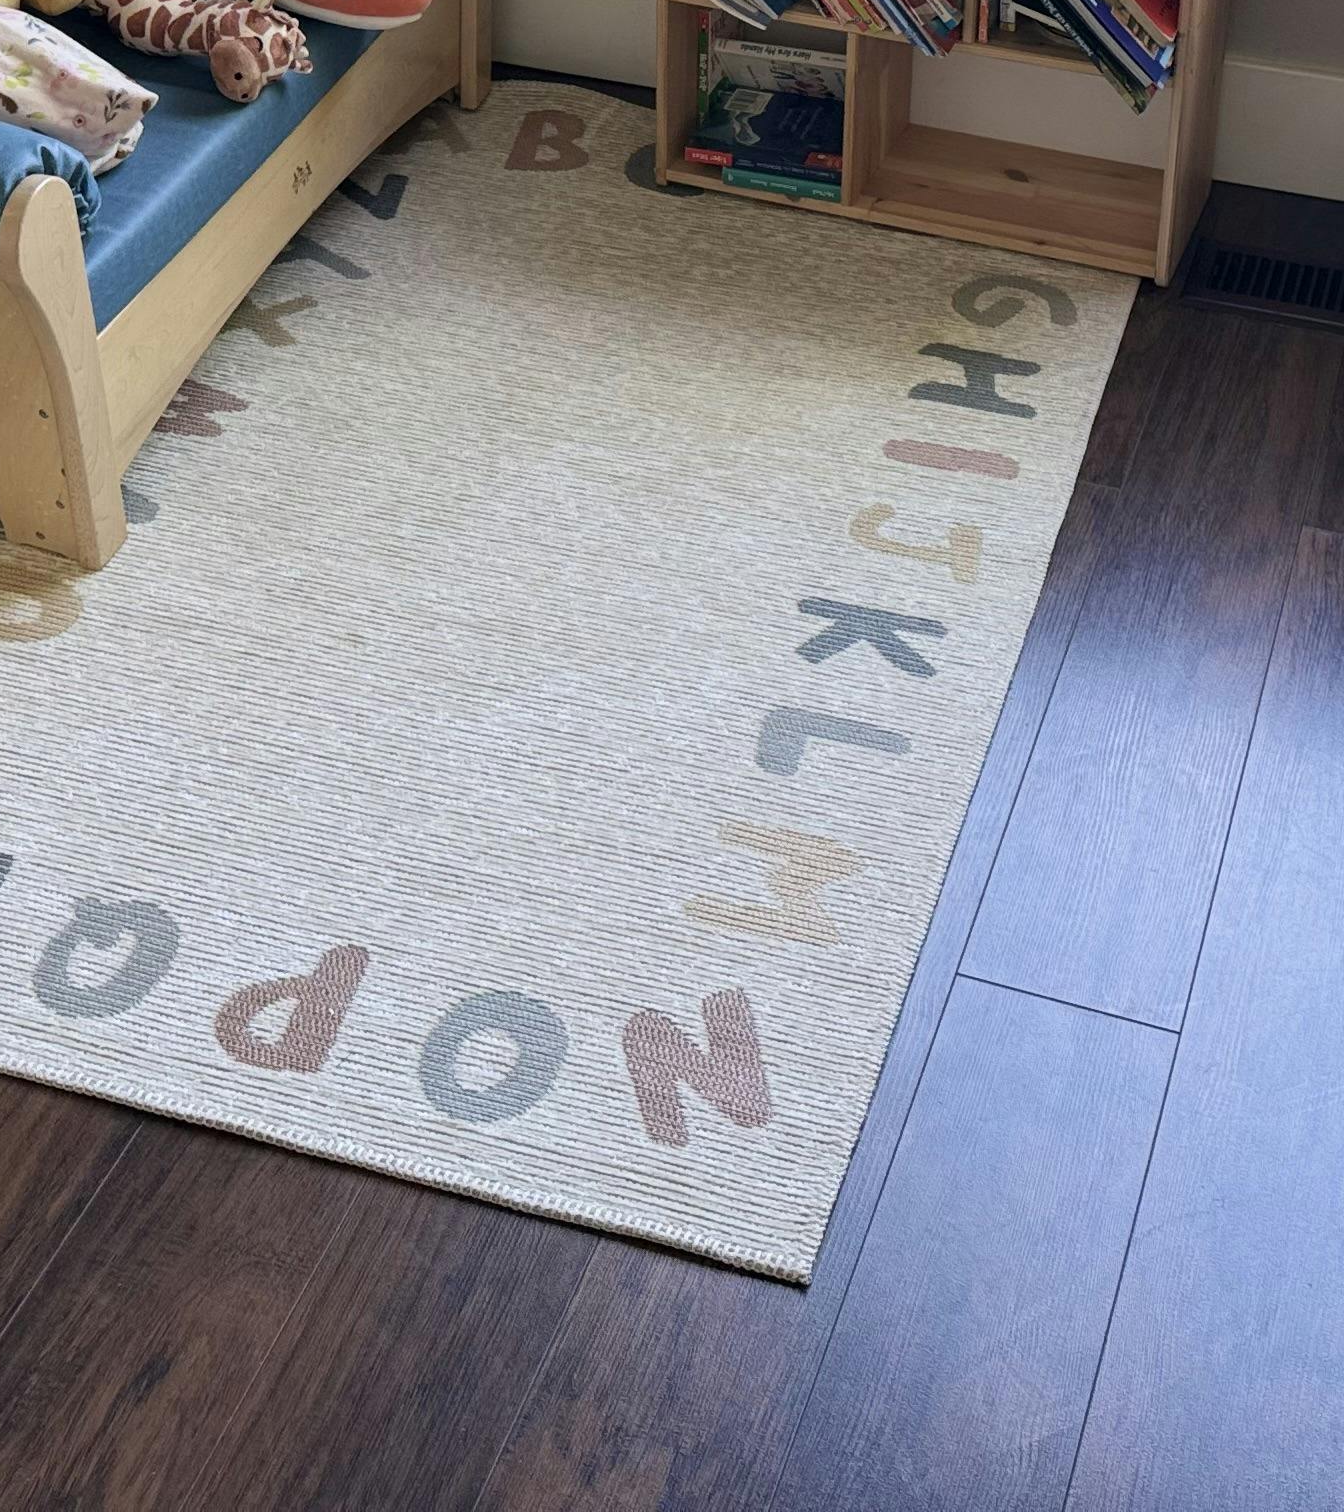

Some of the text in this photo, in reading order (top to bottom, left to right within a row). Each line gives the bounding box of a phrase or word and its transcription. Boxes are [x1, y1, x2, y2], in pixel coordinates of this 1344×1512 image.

[504, 109, 590, 171] B
[683, 274, 1078, 944] G H I J K L M
[32, 896, 180, 1019] Q
[213, 943, 370, 1074] P
[419, 988, 569, 1125] O
[621, 987, 773, 1147] N
